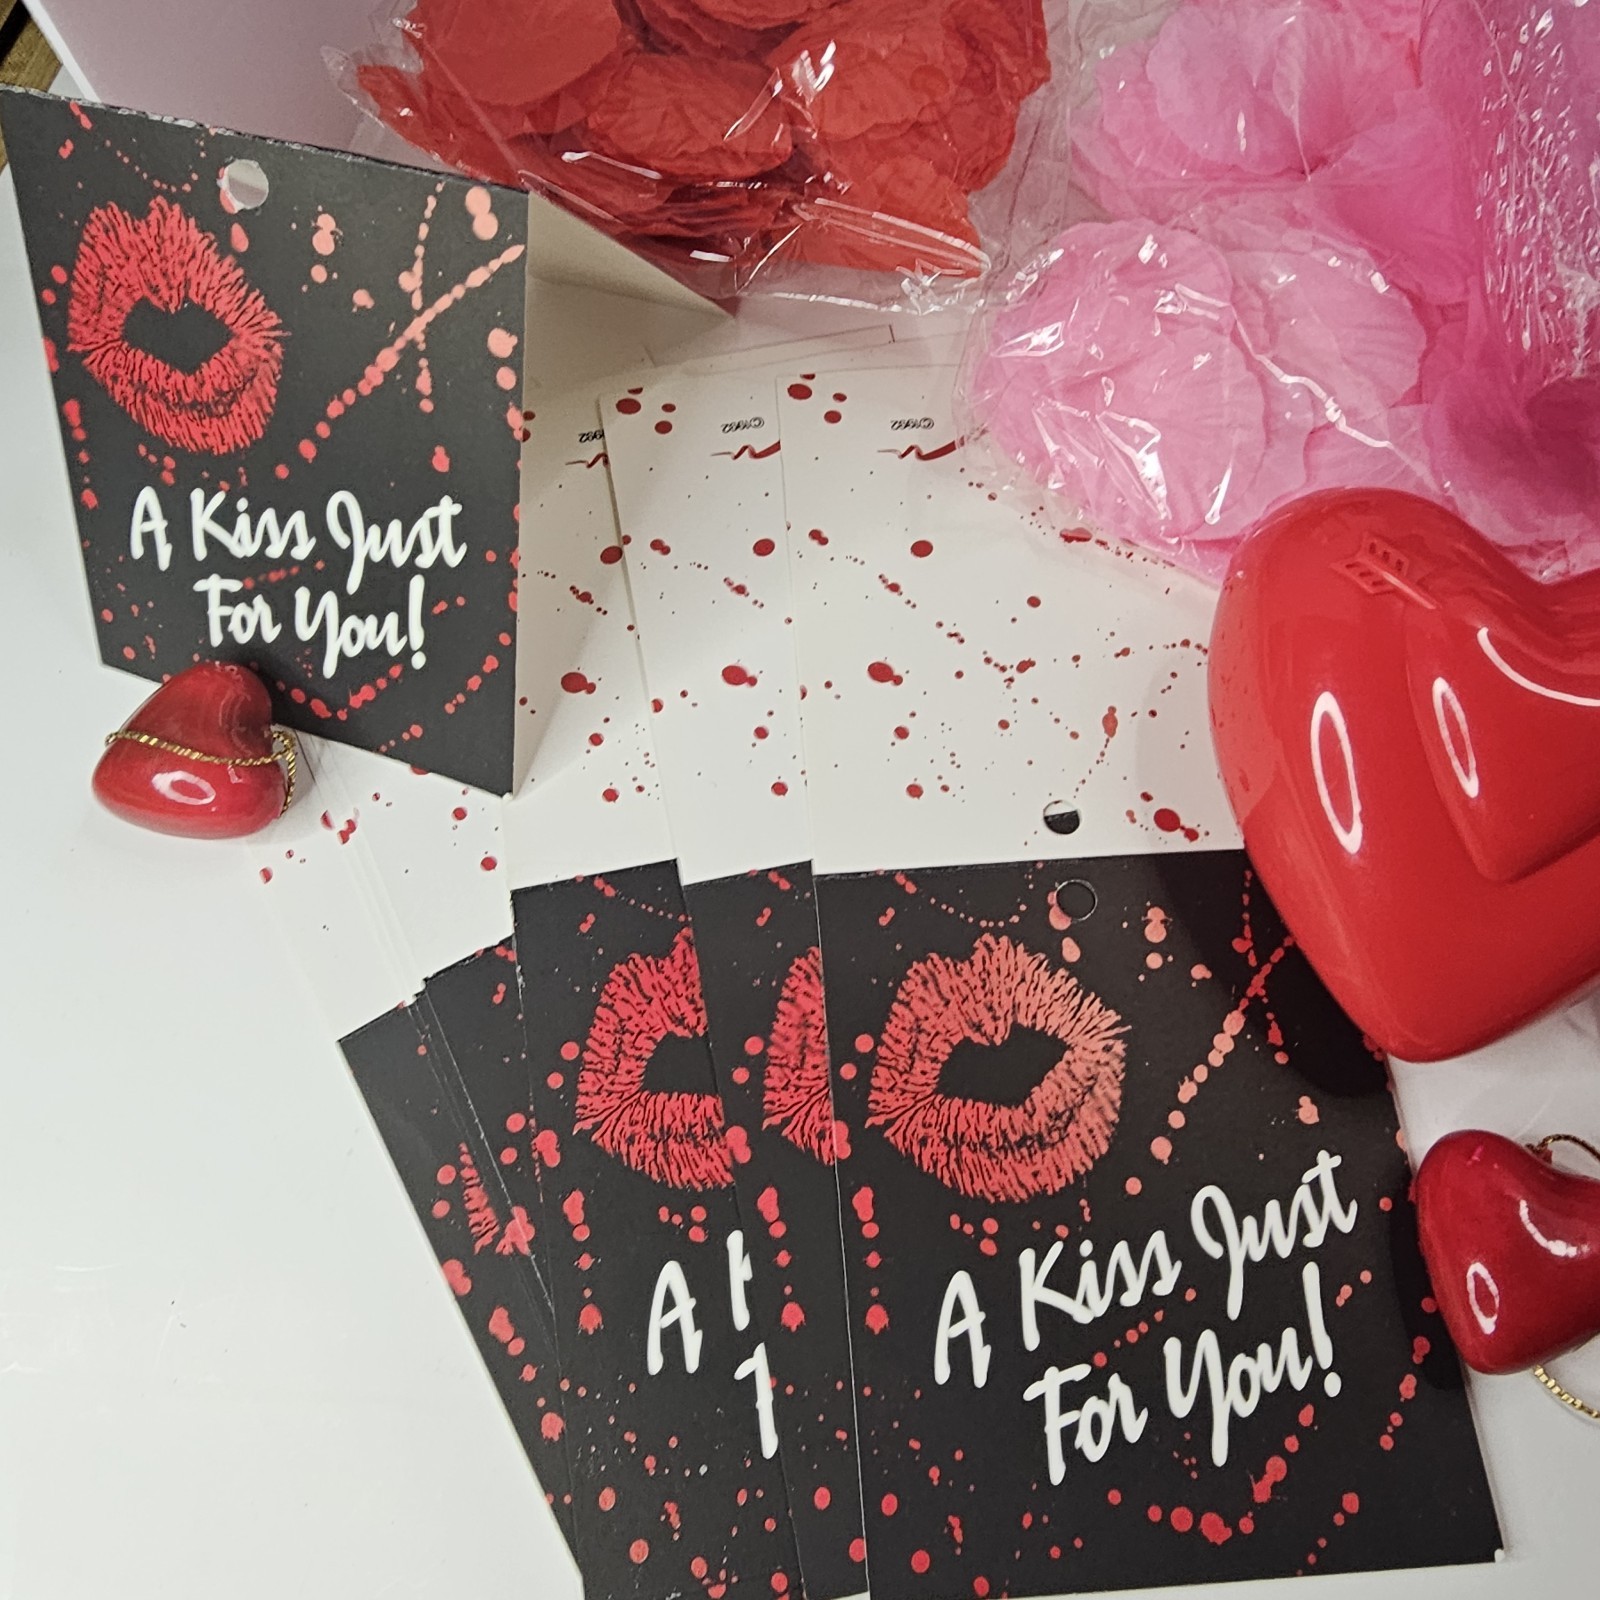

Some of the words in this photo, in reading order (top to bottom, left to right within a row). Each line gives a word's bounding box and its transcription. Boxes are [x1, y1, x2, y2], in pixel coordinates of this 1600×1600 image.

[130, 485, 173, 571] A
[189, 486, 317, 561] Kiss
[325, 489, 468, 595] Just
[192, 573, 282, 648] For
[294, 573, 427, 679] You!
[646, 1259, 704, 1376] A
[933, 1269, 992, 1389] A
[1018, 1229, 1183, 1352] Kiss
[1190, 1149, 1358, 1321] Just
[1022, 1363, 1149, 1487] For
[1162, 1261, 1342, 1467] You!
